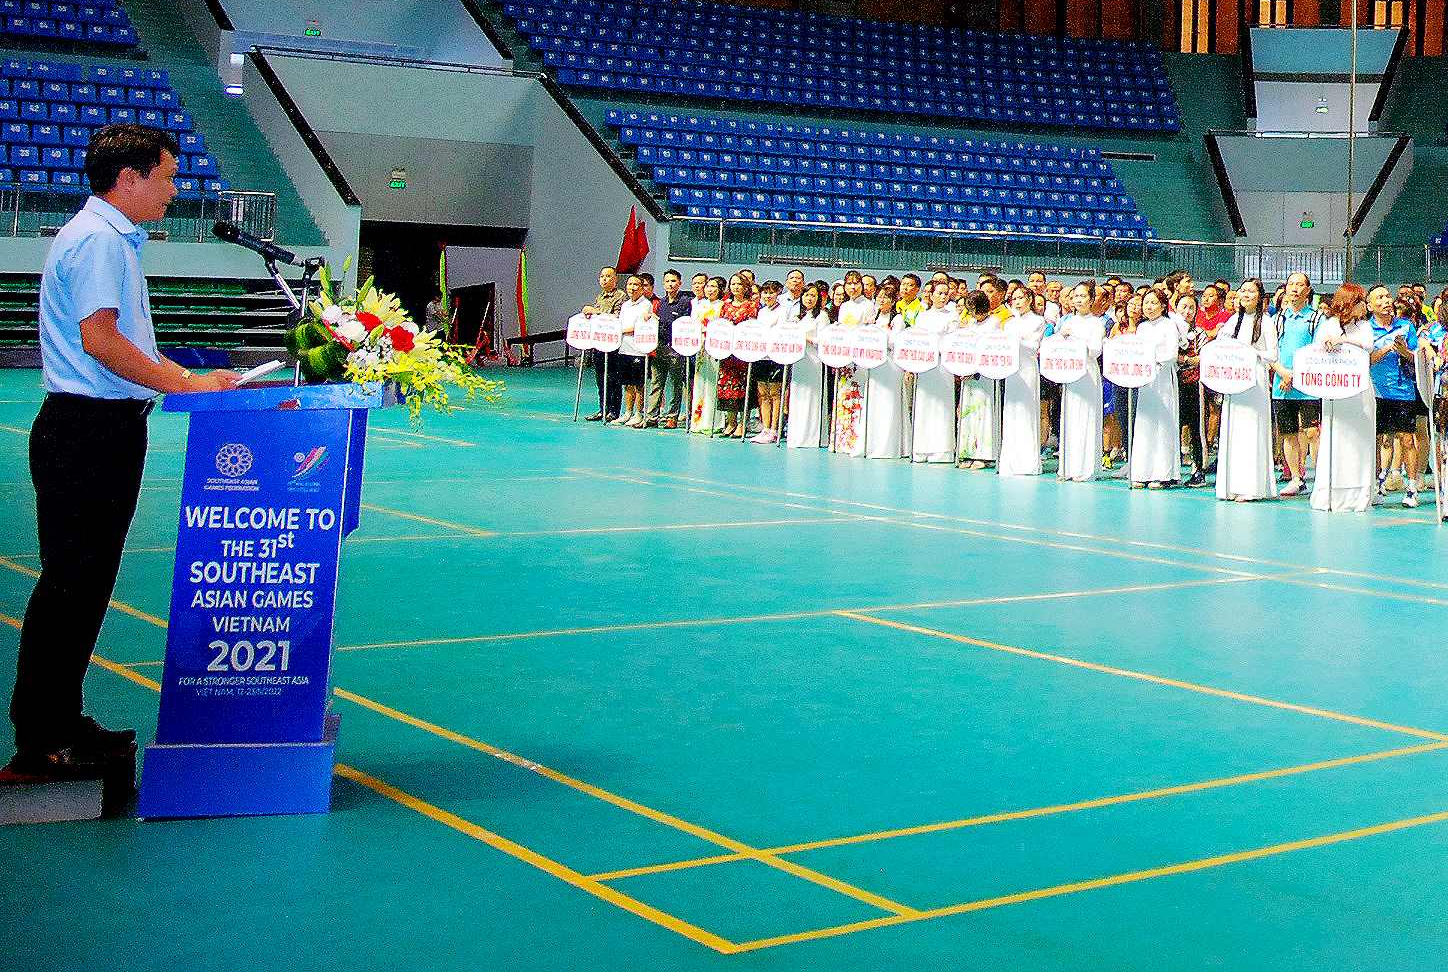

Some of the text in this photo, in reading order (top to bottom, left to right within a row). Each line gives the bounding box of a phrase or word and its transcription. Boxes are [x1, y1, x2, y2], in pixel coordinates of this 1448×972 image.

[1325, 370, 1349, 388] CÔNG
[1351, 374, 1362, 388] TY
[185, 505, 336, 531] WELCOME TO
[221, 531, 295, 558] THE 31st
[190, 561, 320, 584] SOUTHEAST
[191, 590, 314, 609] ASIAN GAMES
[212, 616, 291, 633] VIETNAM
[207, 639, 290, 672] 2021
[178, 676, 309, 686] FOR A STRONGER SOUTHEAST ASIA
